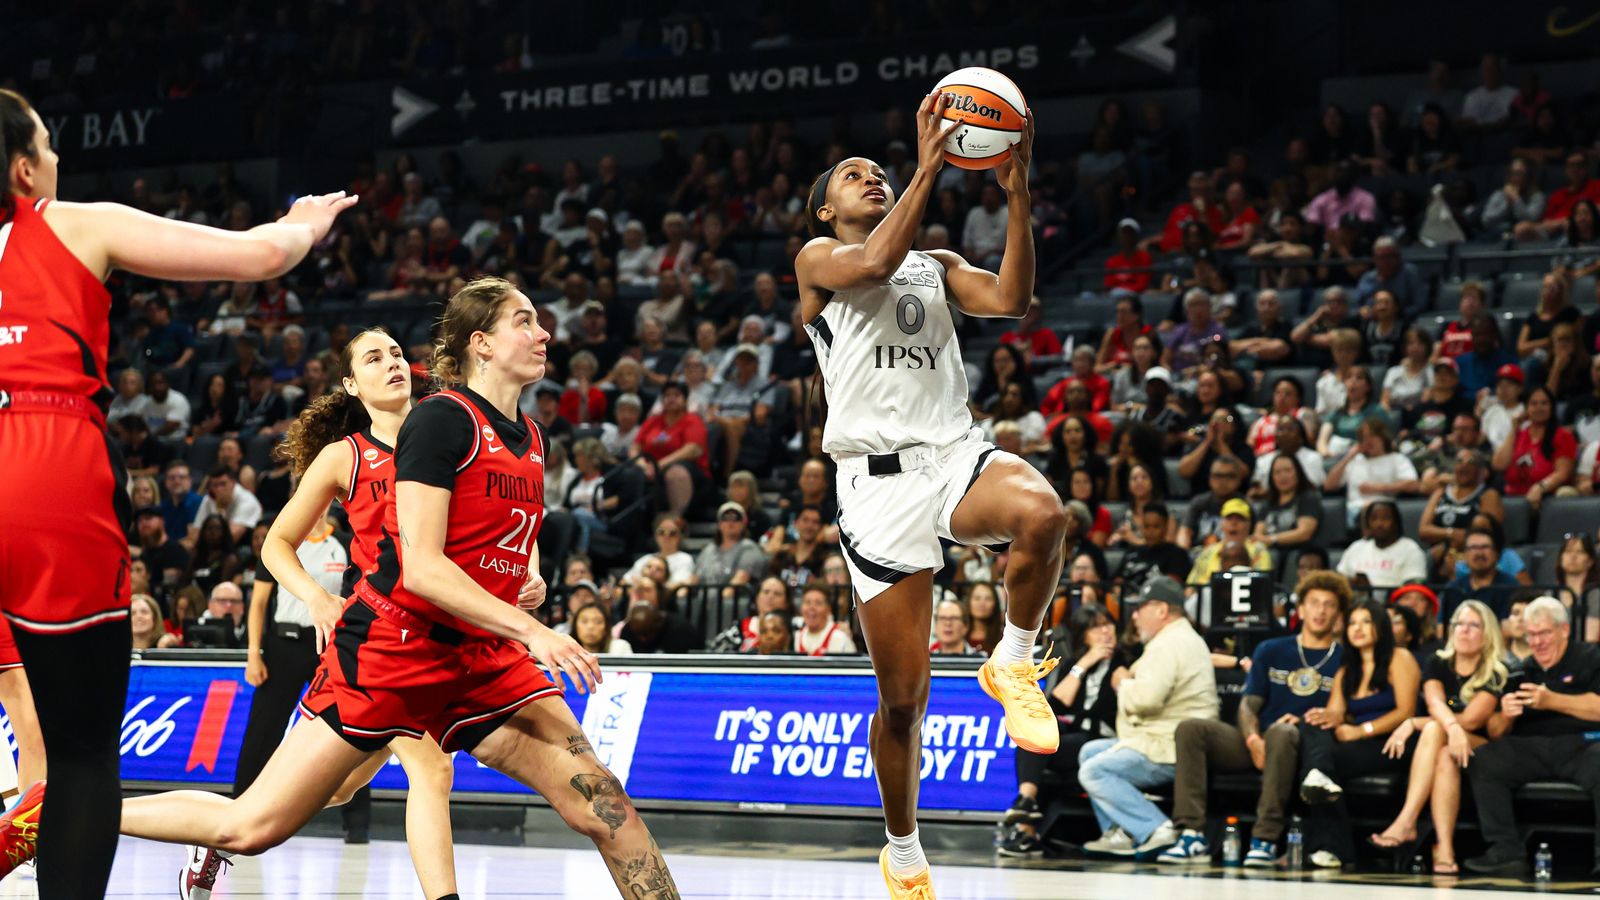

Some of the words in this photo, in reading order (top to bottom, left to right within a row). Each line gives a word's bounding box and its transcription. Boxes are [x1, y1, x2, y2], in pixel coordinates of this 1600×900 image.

[501, 75, 710, 111] THREE-TIME
[729, 62, 859, 93] WORLD
[878, 45, 1039, 81] CHAMPS
[82, 109, 153, 149] BAY
[886, 271, 938, 289] CES
[896, 293, 925, 335] 0
[875, 346, 940, 370] IPSY
[496, 508, 537, 555] 21
[1231, 576, 1252, 612] E
[714, 706, 773, 742] IT'S
[776, 711, 862, 744] ONLY
[868, 714, 990, 747] RTH
[730, 744, 764, 774] IF
[771, 744, 838, 777] YOU
[960, 750, 997, 781] IT
